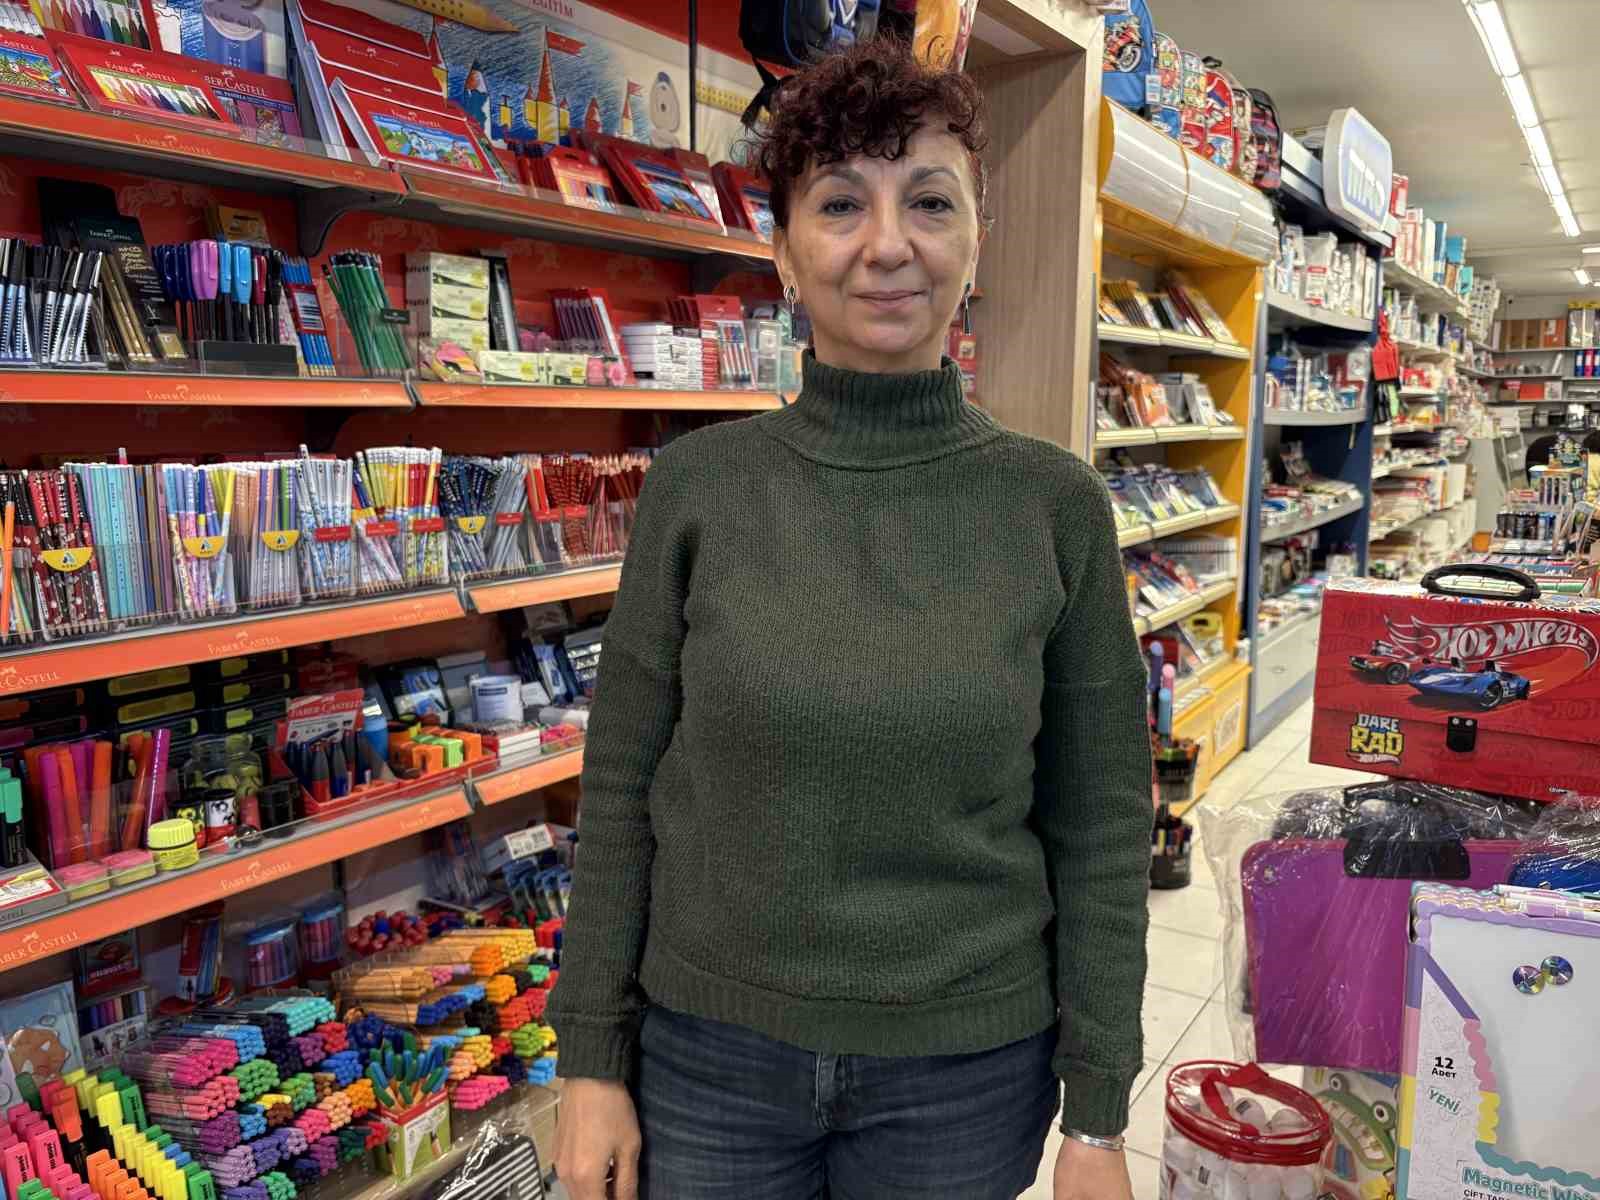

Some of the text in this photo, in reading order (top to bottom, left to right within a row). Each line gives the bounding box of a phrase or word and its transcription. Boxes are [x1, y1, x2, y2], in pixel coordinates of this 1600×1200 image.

[1358, 713, 1400, 733] DARE
[1351, 725, 1403, 755] RAD
[1434, 1055, 1455, 1070] 12
[1462, 1166, 1550, 1200] Magnetic
